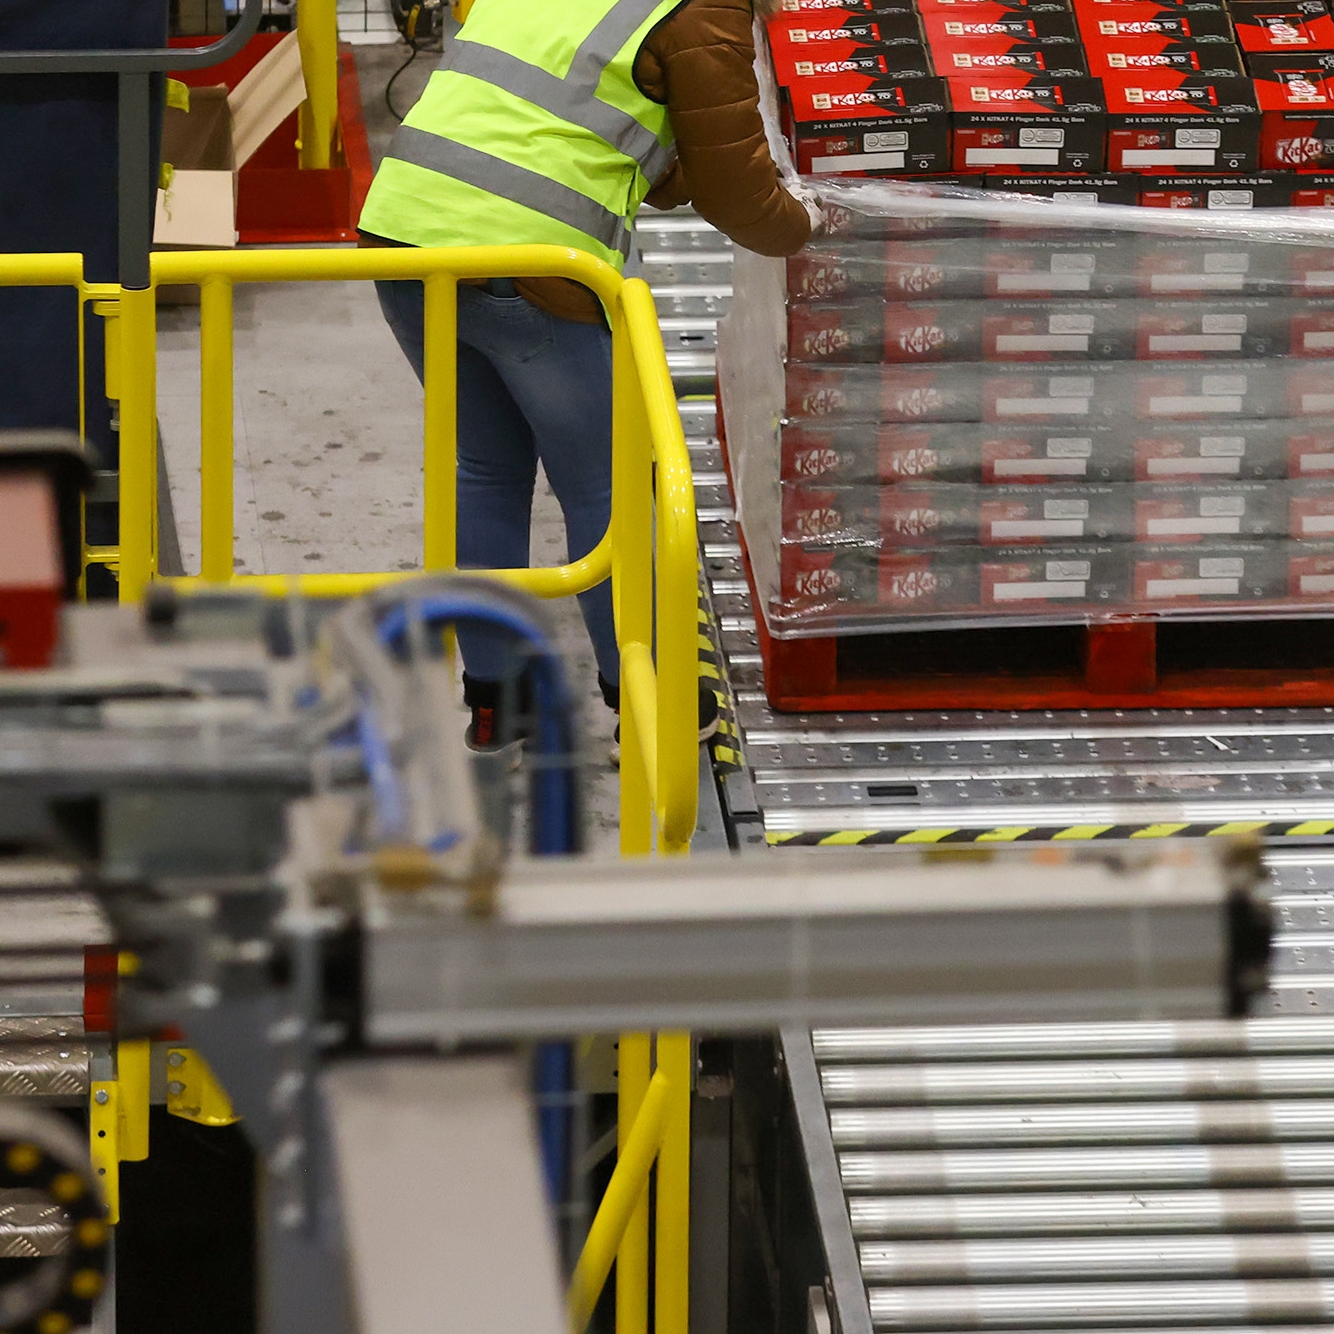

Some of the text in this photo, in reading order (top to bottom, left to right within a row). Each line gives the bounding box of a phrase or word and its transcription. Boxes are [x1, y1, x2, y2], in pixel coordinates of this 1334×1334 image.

[1281, 138, 1322, 163] KitKat
[900, 326, 944, 353] KitKat
[796, 449, 839, 475] KitKat
[796, 570, 841, 595] KitKat
[893, 571, 937, 598] KitKat
